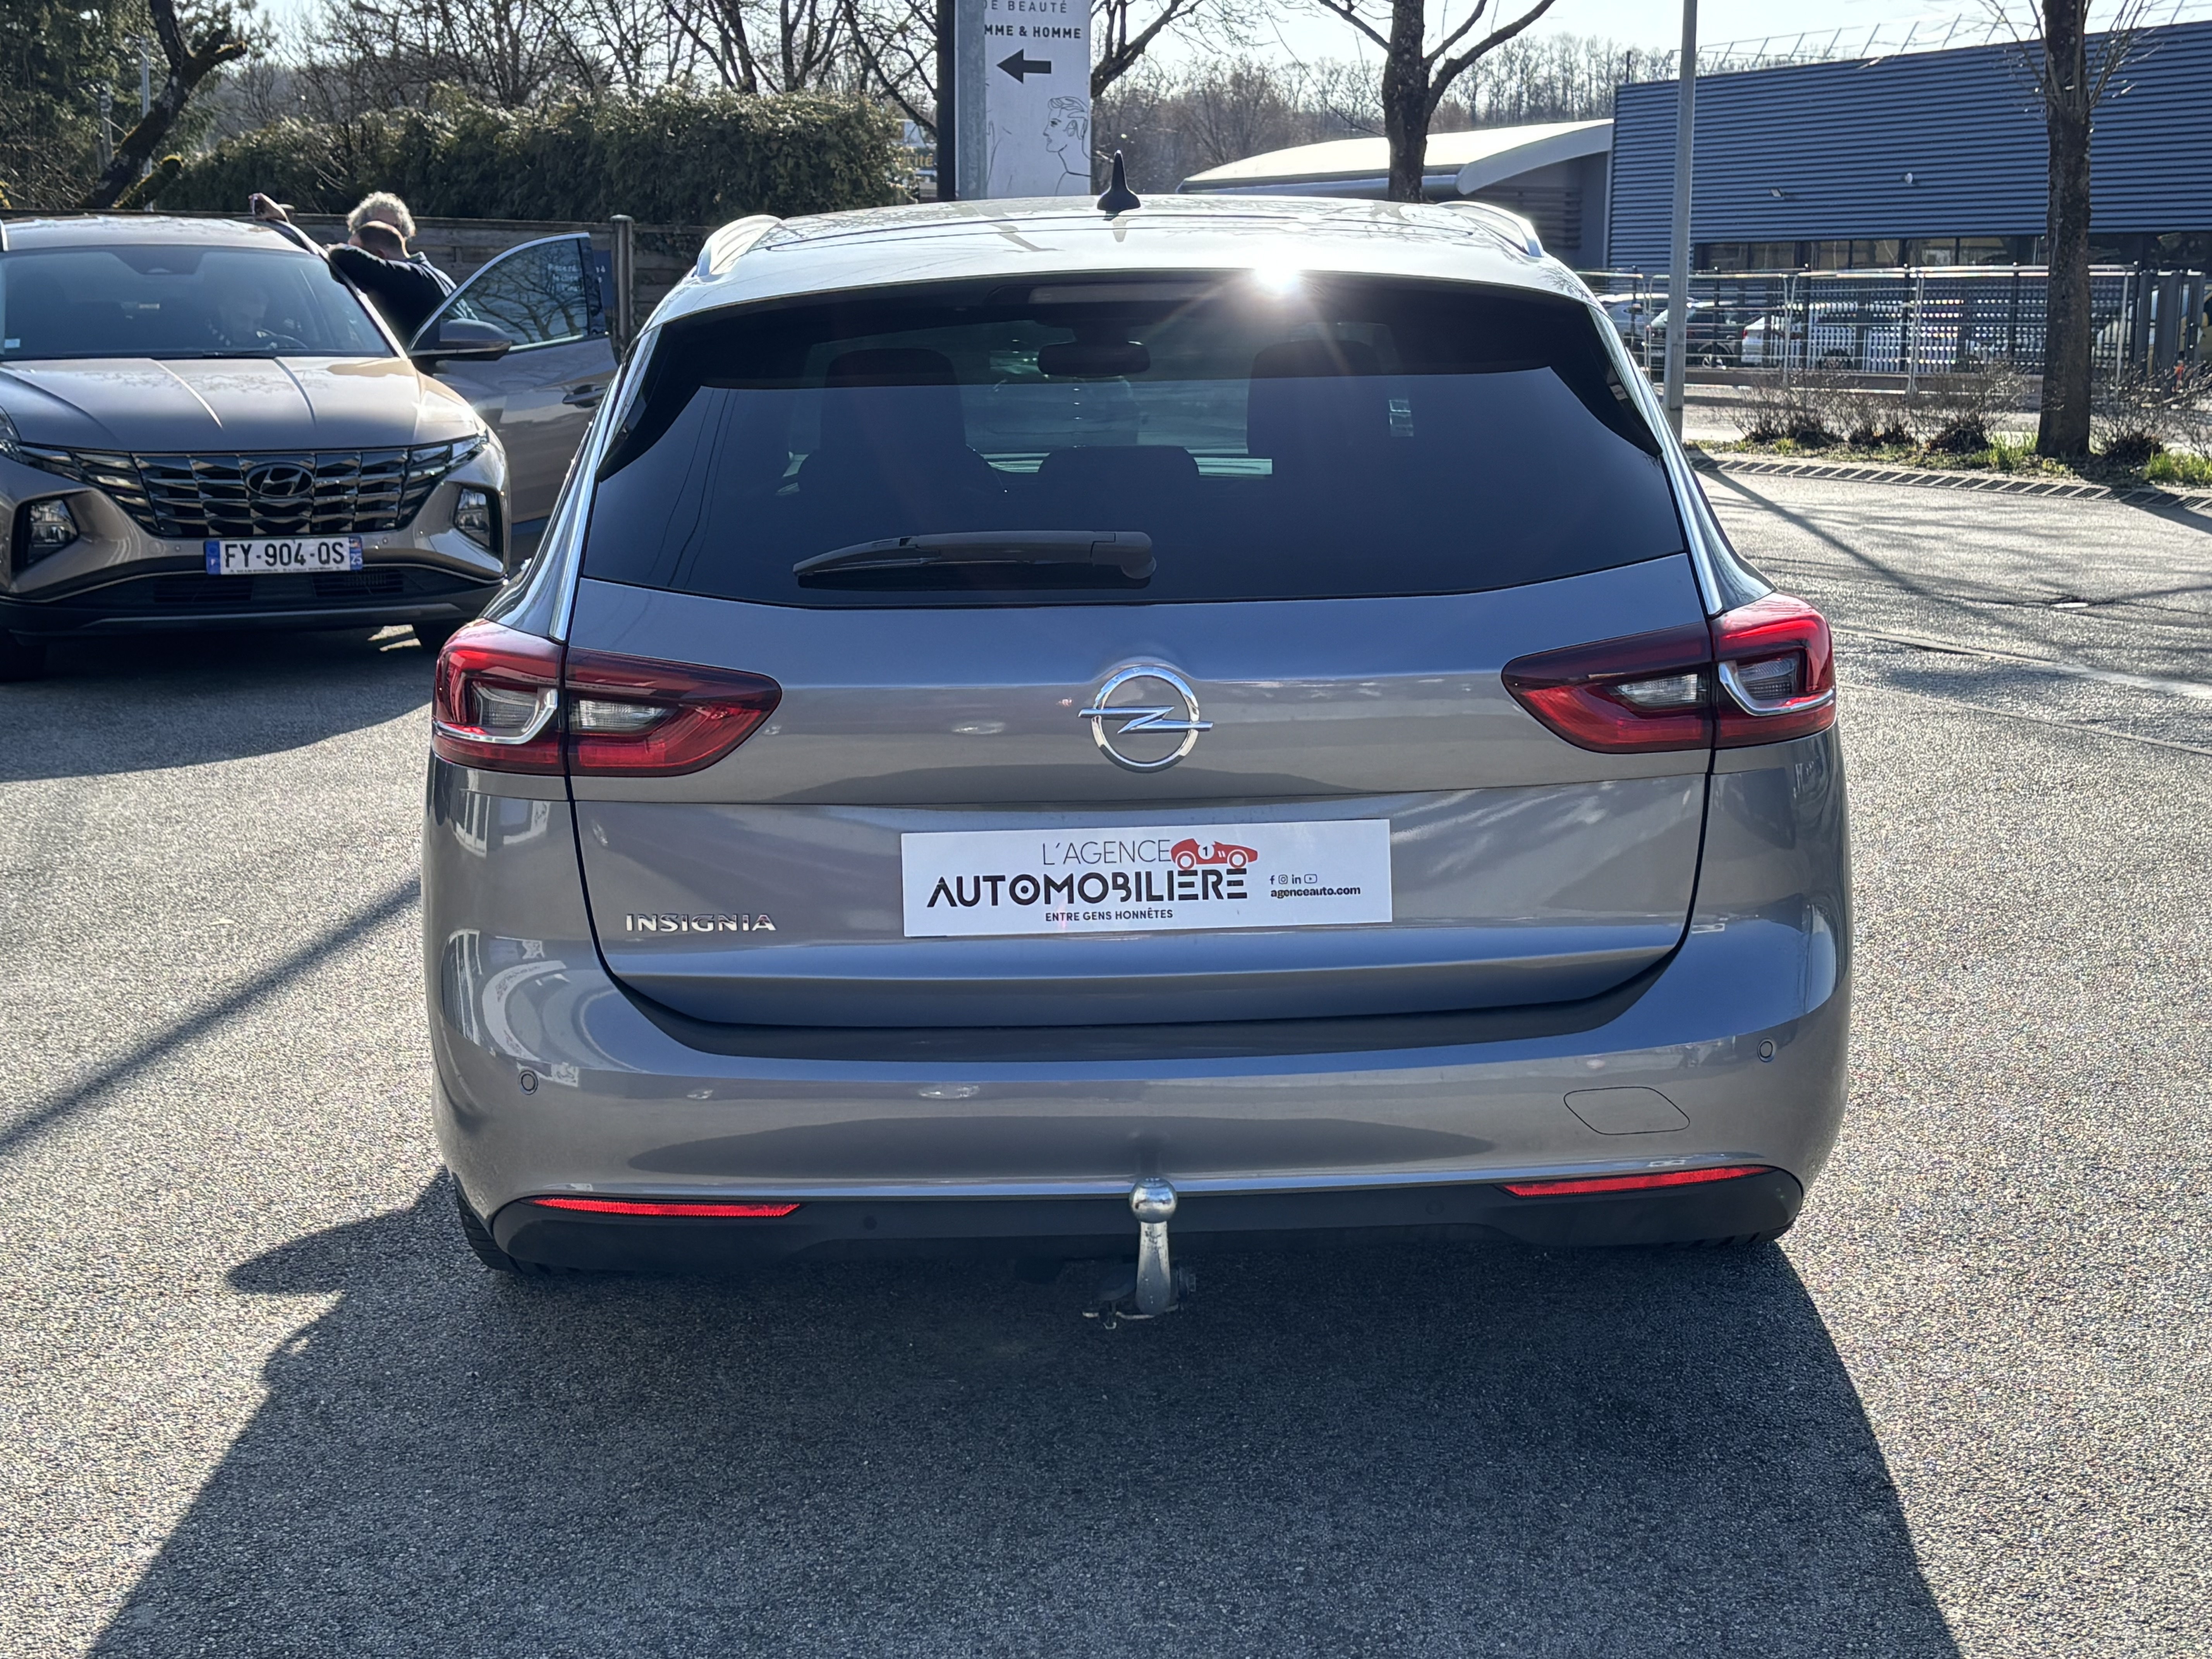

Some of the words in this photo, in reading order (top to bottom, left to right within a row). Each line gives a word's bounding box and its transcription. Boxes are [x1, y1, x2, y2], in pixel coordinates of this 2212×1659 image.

[1008, 0, 1067, 13] BEAUTÉ
[984, 24, 1013, 36] MME
[1019, 26, 1027, 36] &
[1033, 26, 1081, 39] HOMME
[225, 542, 345, 568] FY-904-QS
[350, 553, 363, 565] 25
[1042, 840, 1171, 865] L'AGENCE
[1203, 846, 1208, 856] 1
[1270, 886, 1361, 899] agenceauto.com
[1045, 912, 1080, 922] ENTRE
[1083, 910, 1112, 921] GENS
[1115, 907, 1173, 920] HONNÊTES
[626, 914, 777, 932] INSIGNIA
